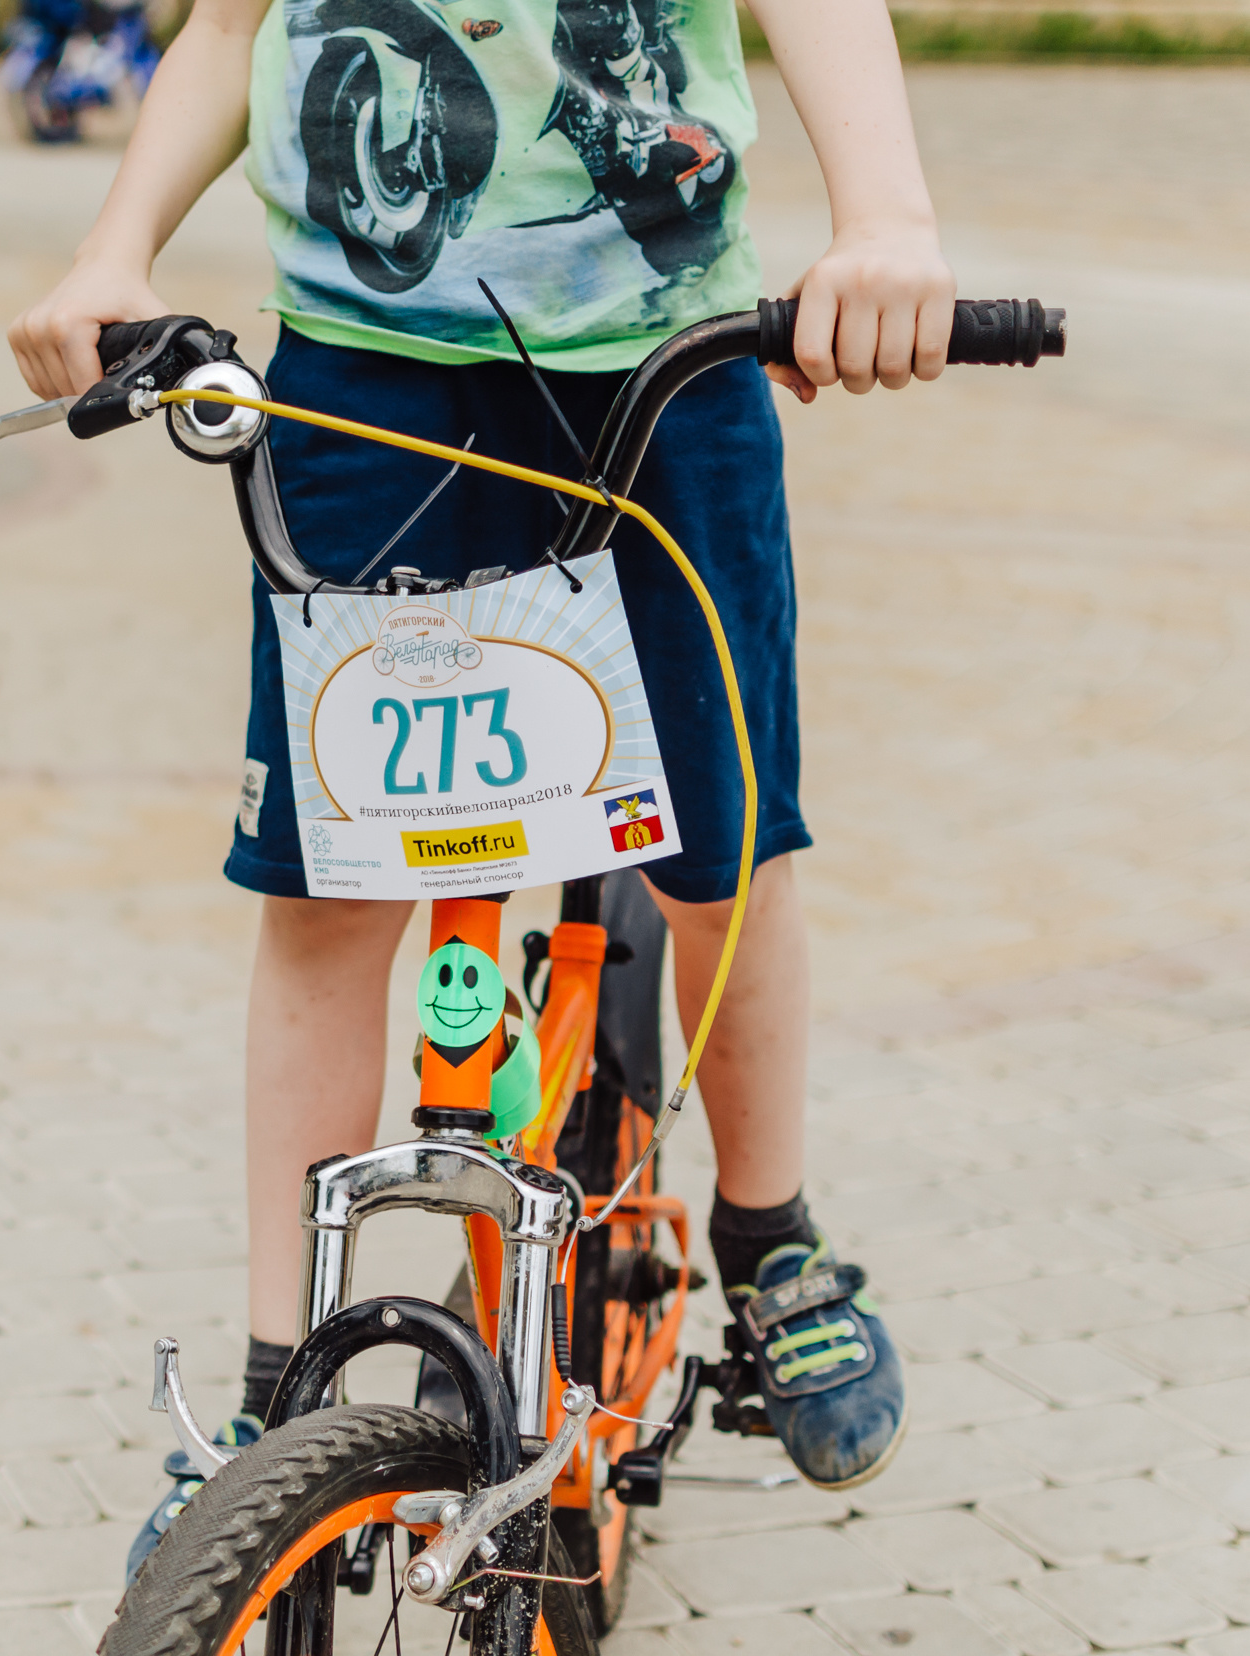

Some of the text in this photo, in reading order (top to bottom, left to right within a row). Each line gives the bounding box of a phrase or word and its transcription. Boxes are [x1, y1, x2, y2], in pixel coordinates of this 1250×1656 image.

[388, 616, 445, 630] ПЯТИГОРСКИЙ
[372, 687, 528, 795] 273
[359, 783, 573, 820] #пятигорскийвелопарад2018
[412, 834, 516, 858] Tinkoff.ru
[313, 857, 382, 868] ВЕЛОСООБЩЕСТВО
[314, 866, 329, 874] КМВ
[316, 878, 362, 888] организатор
[420, 871, 524, 888] генеральный спонсор
